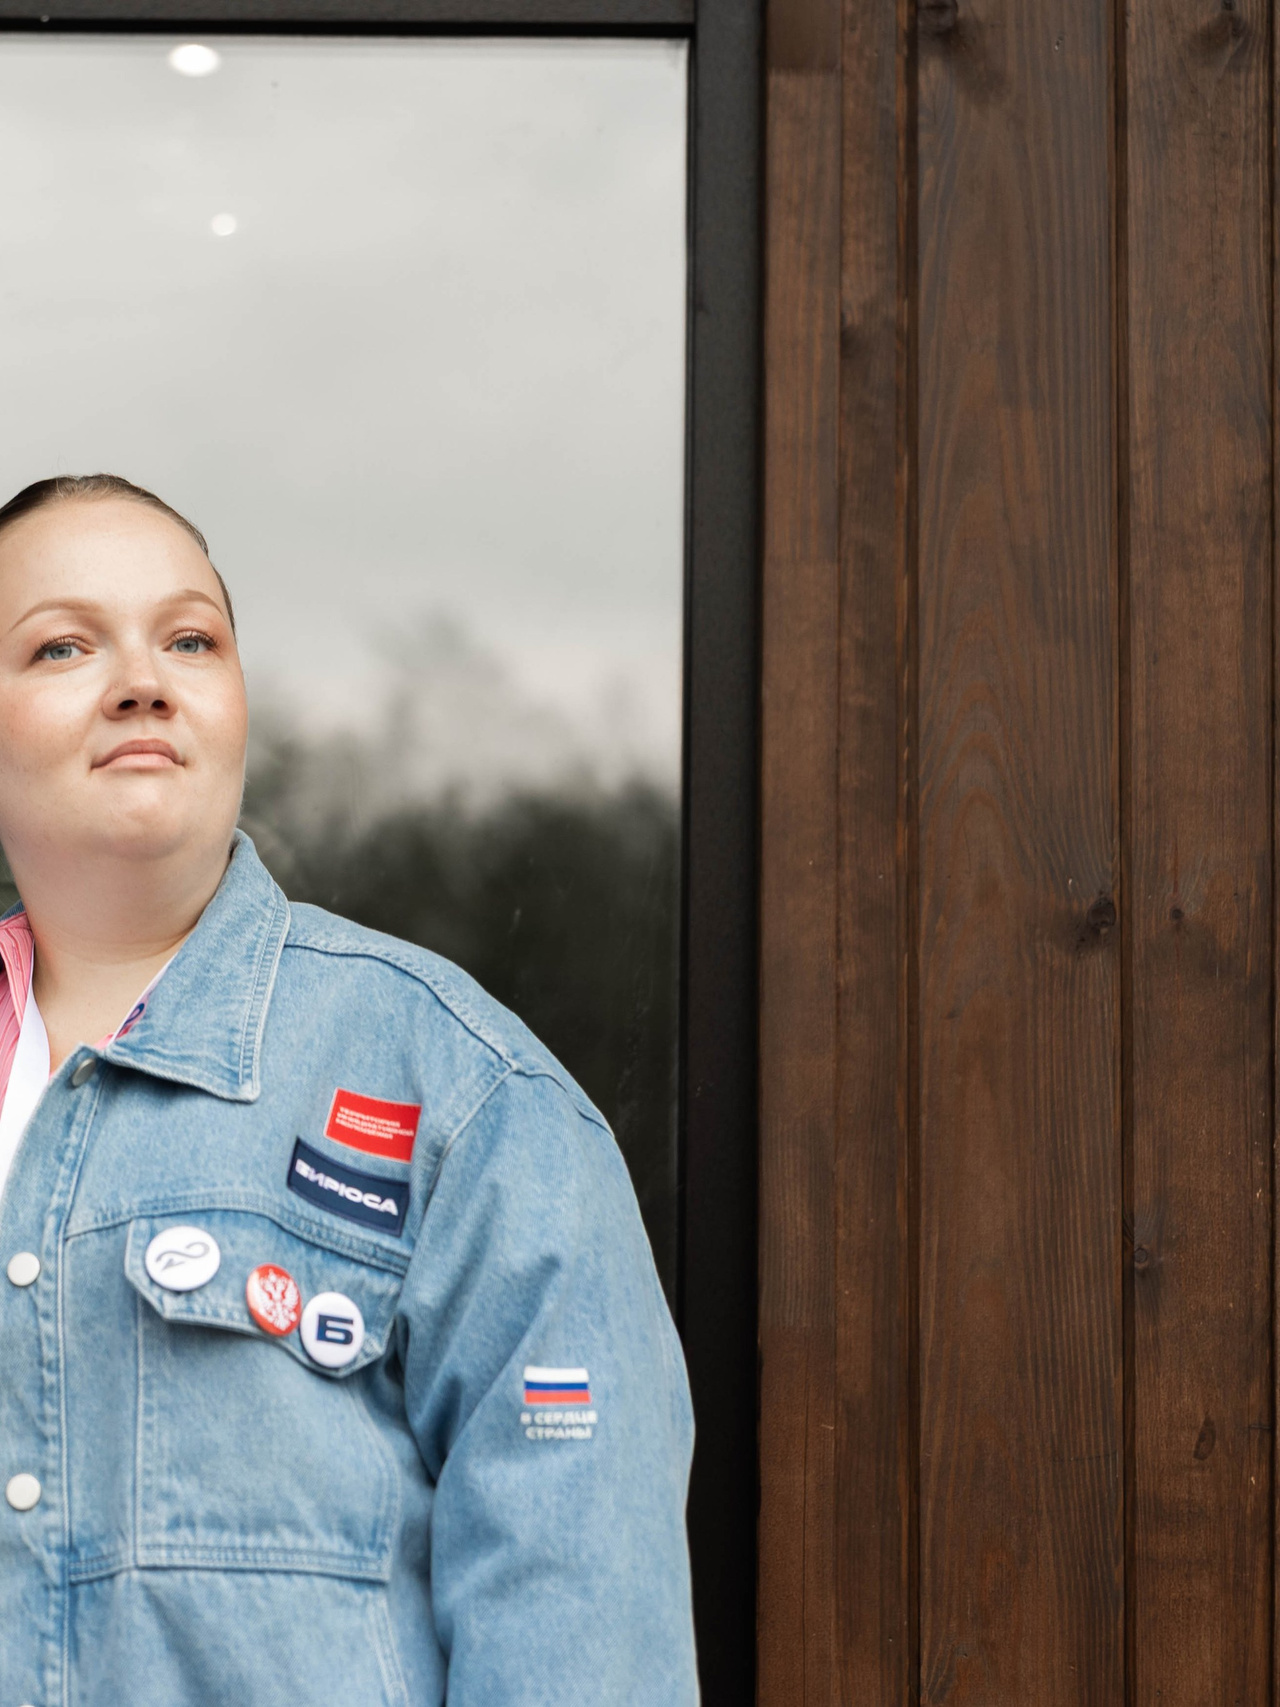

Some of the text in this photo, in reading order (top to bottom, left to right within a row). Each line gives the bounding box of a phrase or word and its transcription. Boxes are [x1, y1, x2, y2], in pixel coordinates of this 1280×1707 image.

[295, 1158, 399, 1216] БИРЮСА
[316, 1313, 354, 1346] Б
[525, 1426, 592, 1440] СТРАНЫ
